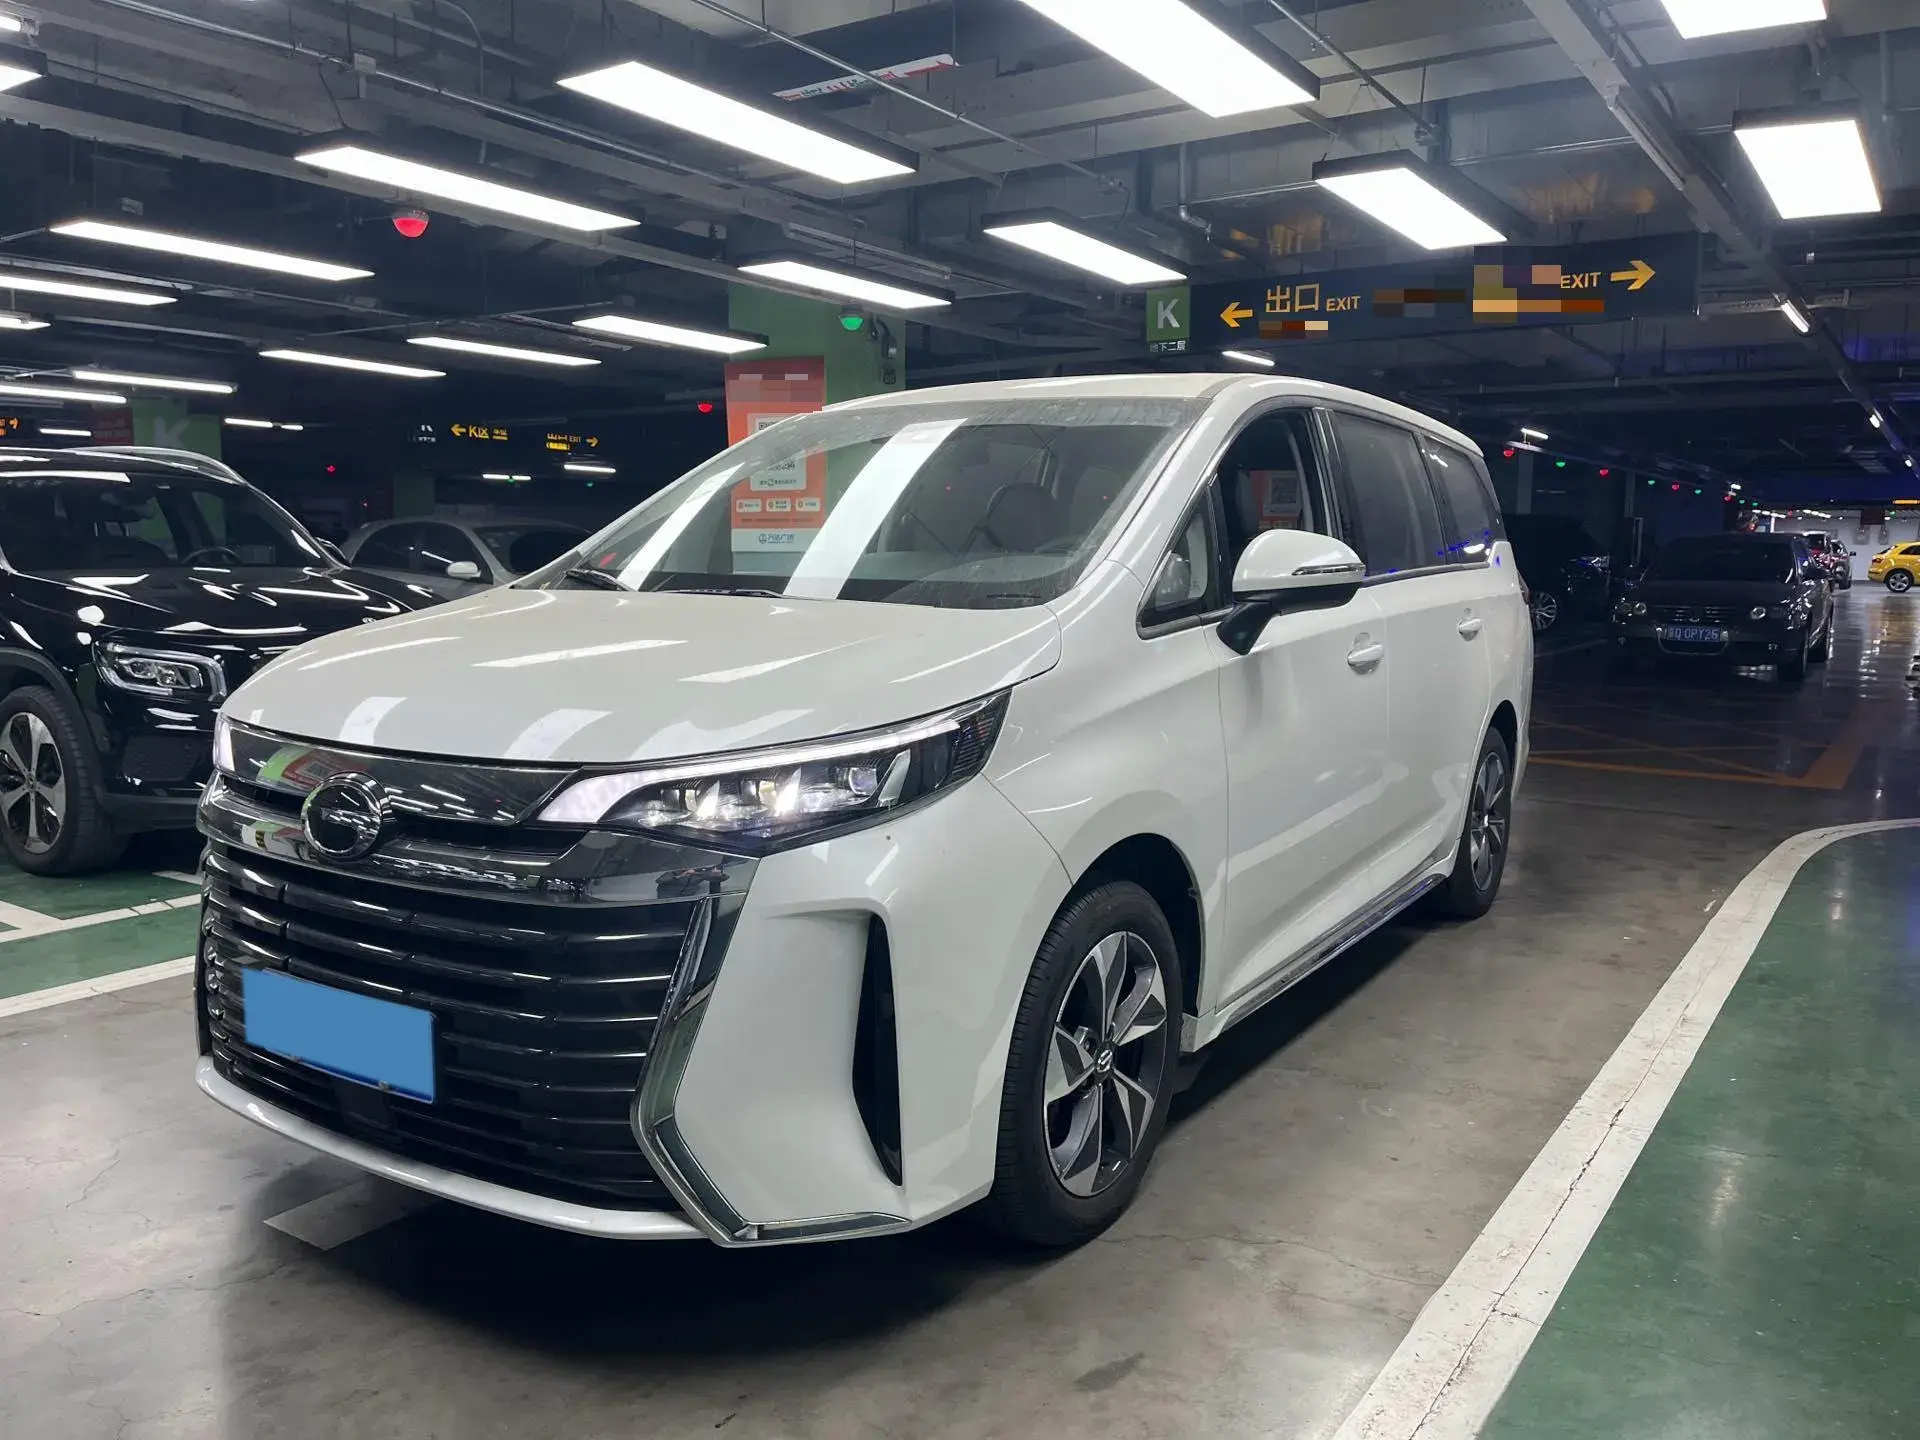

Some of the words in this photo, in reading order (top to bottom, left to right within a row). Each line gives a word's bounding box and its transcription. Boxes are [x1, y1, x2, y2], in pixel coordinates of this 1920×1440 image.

[1560, 272, 1601, 288] EXIT
[1265, 284, 1320, 312] 出口
[1325, 296, 1361, 312] EXIT
[1157, 298, 1181, 329] K
